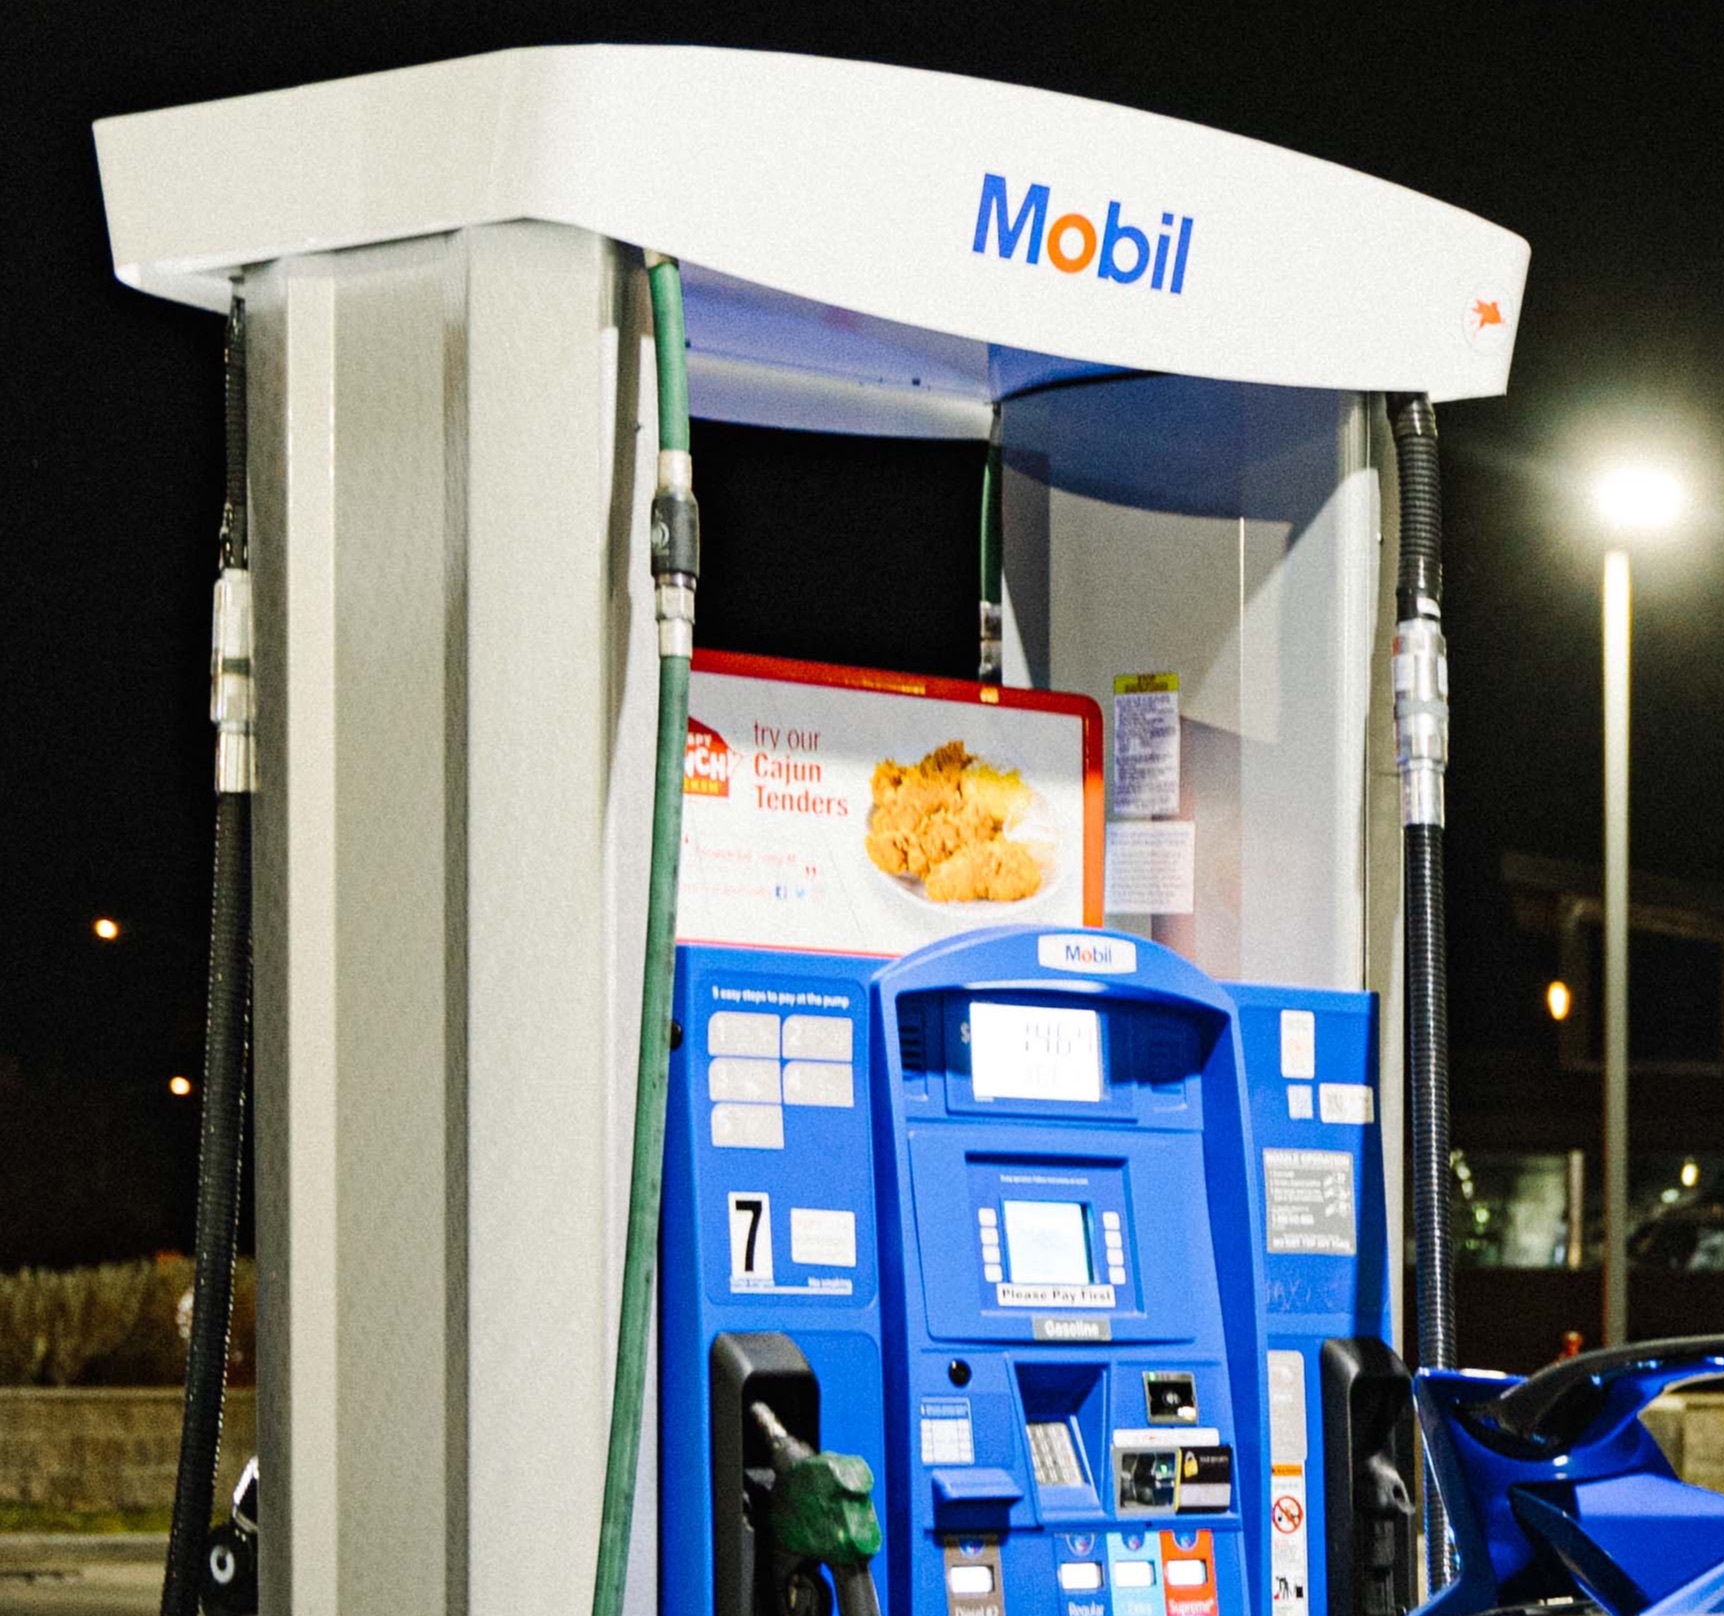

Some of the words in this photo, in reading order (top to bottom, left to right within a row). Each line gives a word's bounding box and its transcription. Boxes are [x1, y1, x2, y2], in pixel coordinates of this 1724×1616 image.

[973, 173, 1193, 294] Mobil
[754, 718, 780, 750] try
[787, 728, 821, 751] our
[754, 752, 822, 785] Cajun
[755, 785, 849, 817] Tenders
[1065, 945, 1112, 963] Mobil
[735, 1200, 762, 1273] 7
[1002, 1287, 1047, 1300] Please
[1052, 1287, 1076, 1303] Pay
[1081, 1287, 1111, 1300] First
[1044, 1319, 1099, 1337] Gasoline
